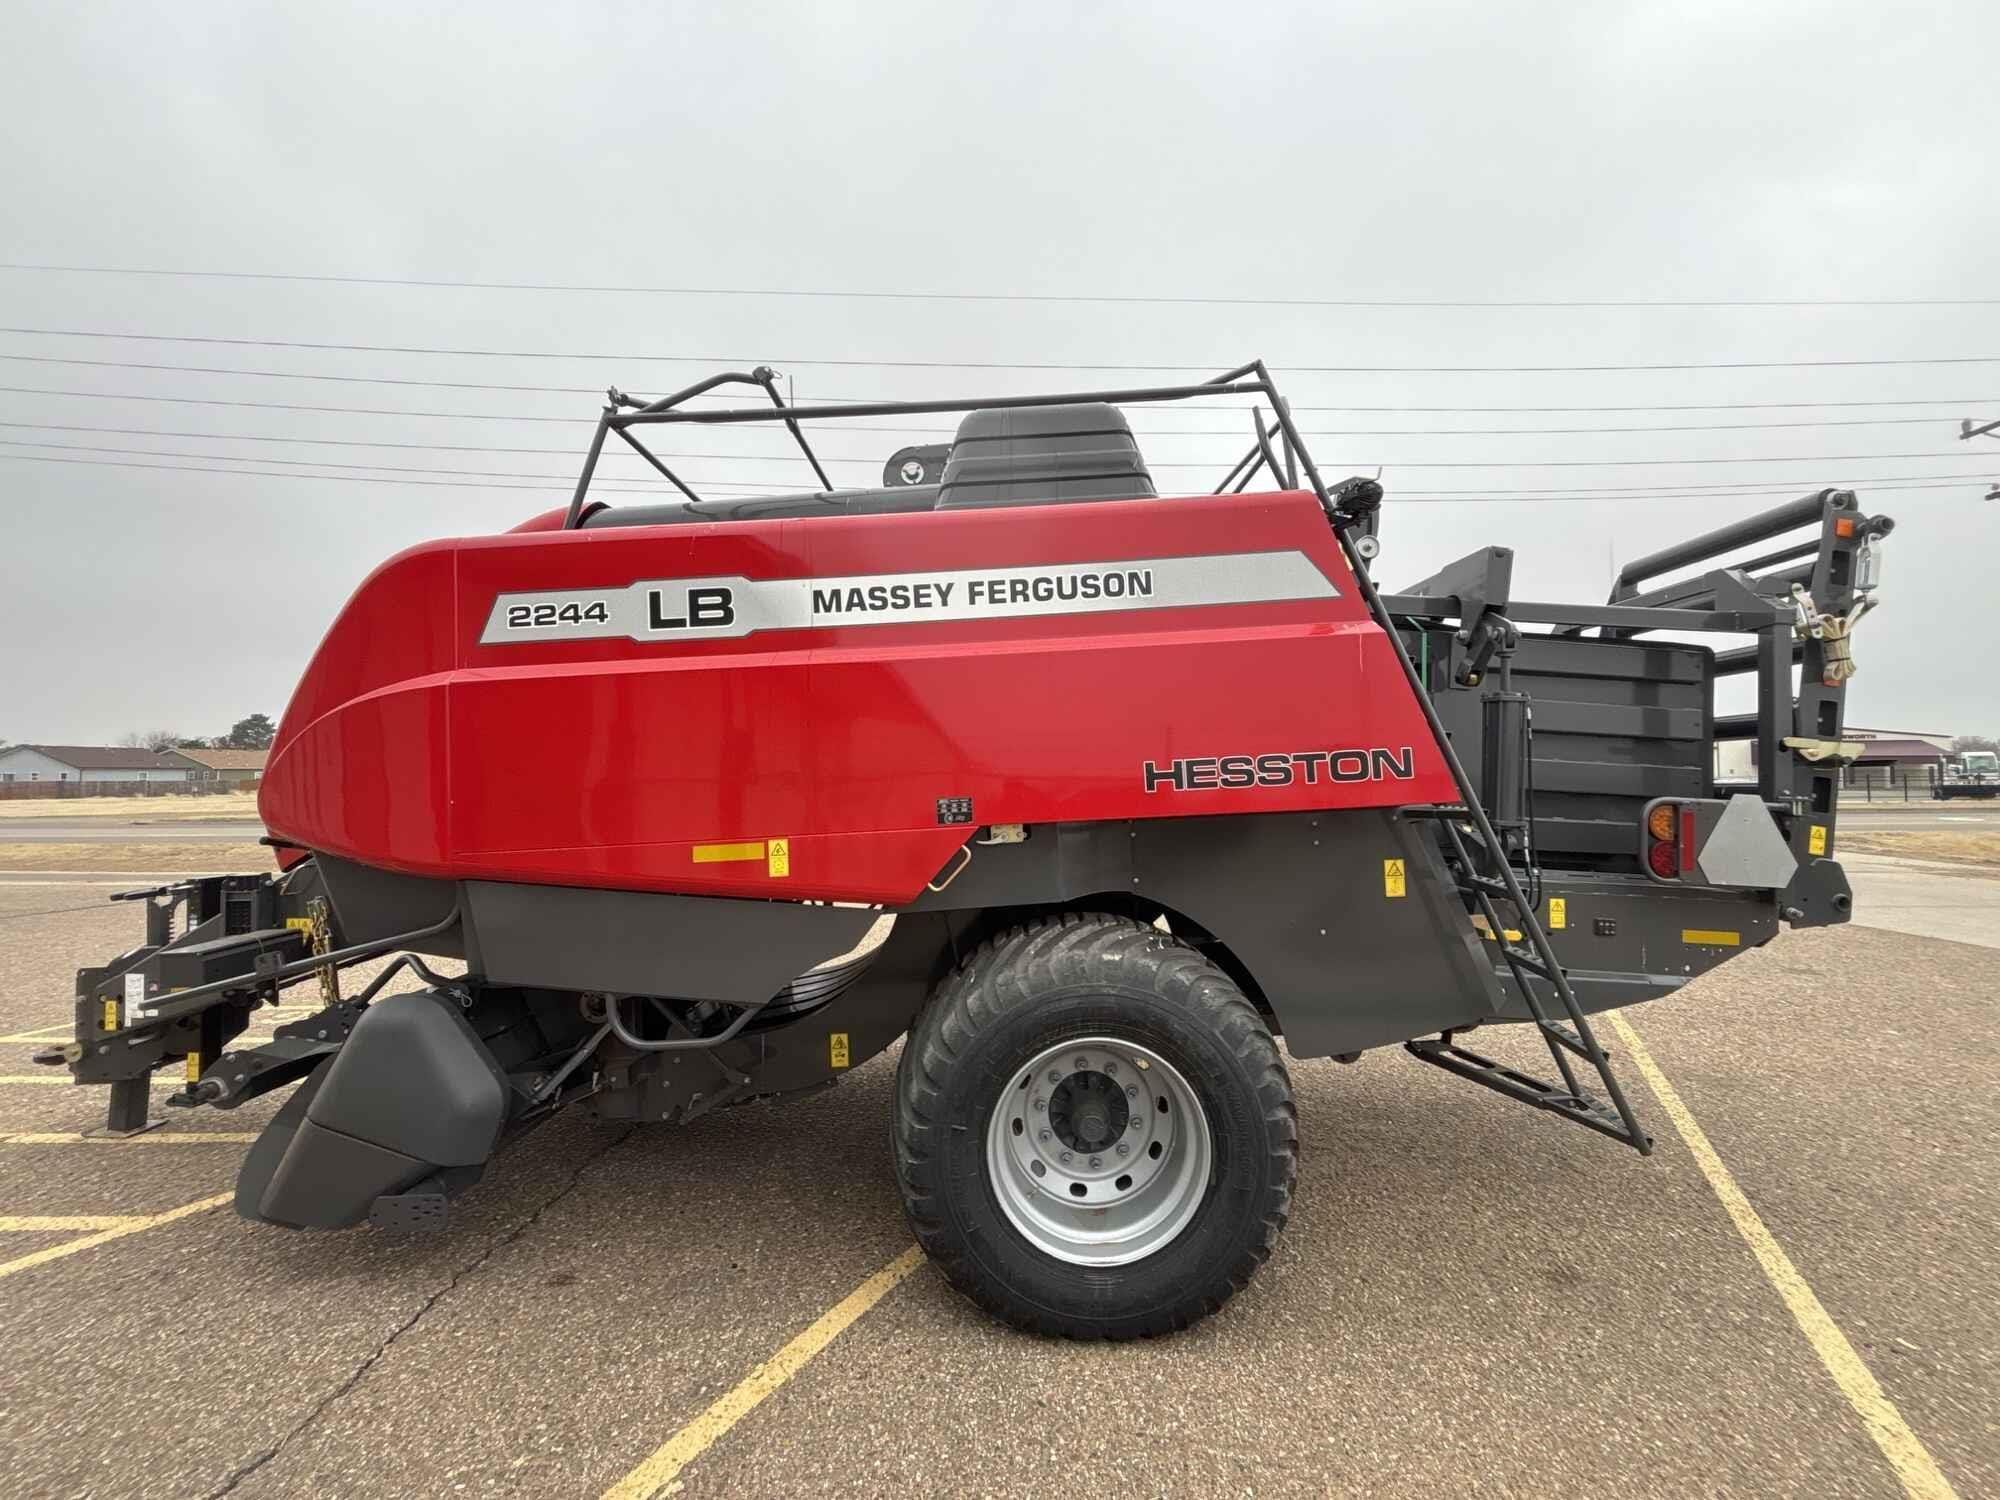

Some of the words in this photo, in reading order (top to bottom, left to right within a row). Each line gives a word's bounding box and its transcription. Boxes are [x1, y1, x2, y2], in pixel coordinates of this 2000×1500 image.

[507, 601, 609, 628] 2244
[647, 587, 735, 631] LB
[812, 582, 955, 614] MASSEY
[967, 570, 1153, 606] FERGUSON
[1144, 746, 1415, 793] HESSTON
